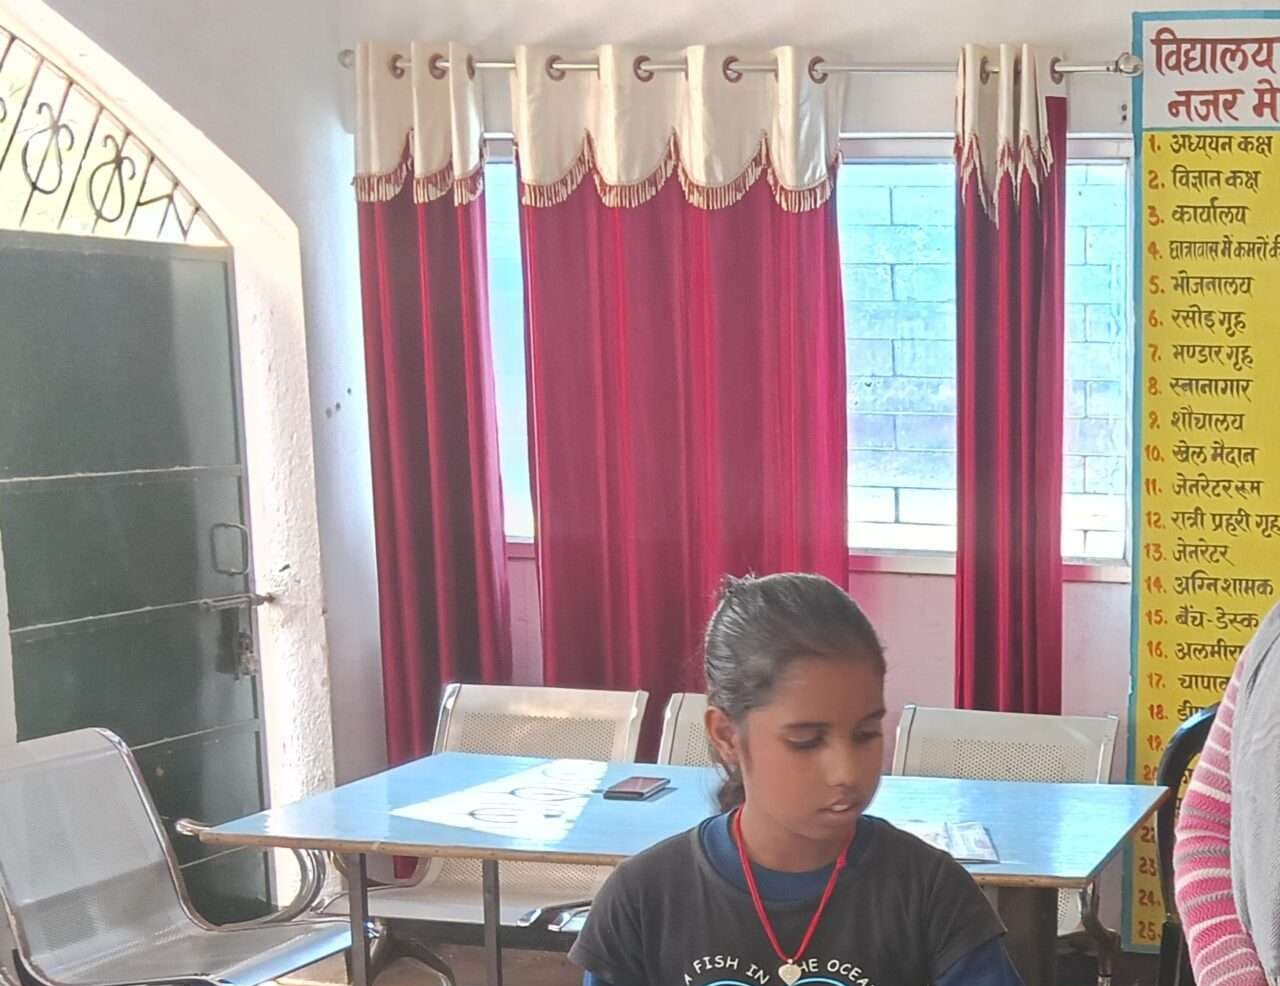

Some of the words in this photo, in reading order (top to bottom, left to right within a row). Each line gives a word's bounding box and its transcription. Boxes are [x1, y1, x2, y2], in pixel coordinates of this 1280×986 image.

[1168, 88, 1244, 123] नजर
[1148, 134, 1161, 152] 1.
[1238, 135, 1273, 158] कक्ष
[1148, 170, 1165, 189] 2.
[1225, 170, 1262, 193] कक्ष
[1147, 205, 1165, 226] 3.
[1171, 196, 1250, 225] कार्यालय
[1147, 242, 1163, 260] 4.
[1220, 234, 1233, 261] में
[1233, 235, 1268, 264] कमरों
[1149, 276, 1165, 296] 5.
[1171, 270, 1254, 297] भोजनालय
[1148, 310, 1163, 327] 6.
[1219, 311, 1247, 338] गृह
[1147, 344, 1162, 362] 7.
[1172, 344, 1225, 365] भण्डार
[1226, 345, 1254, 372] गृह
[1147, 377, 1162, 396] 8.
[1169, 377, 1253, 402] स्नानागार
[1148, 411, 1160, 430] 9.
[1171, 404, 1245, 433] शौचालय
[1144, 445, 1165, 463] 10.
[1172, 440, 1207, 465] खेल
[1210, 440, 1259, 467] मैदान
[1144, 478, 1163, 496] 11.
[1235, 480, 1264, 499] रूम
[1146, 511, 1166, 529] 12.
[1171, 506, 1204, 531] रात्री
[1211, 508, 1251, 537] प्रहरी
[1144, 543, 1167, 561] 13.
[1145, 576, 1167, 594] 14.
[1173, 570, 1219, 597] अग्नि
[1223, 577, 1274, 597] शामक
[1145, 609, 1168, 626] 15.
[1147, 640, 1168, 659] 16.
[1147, 672, 1166, 689] 17.
[1148, 704, 1168, 720] 18.
[692, 955, 739, 974] FISH
[745, 965, 770, 985] IN
[799, 958, 819, 973] HE
